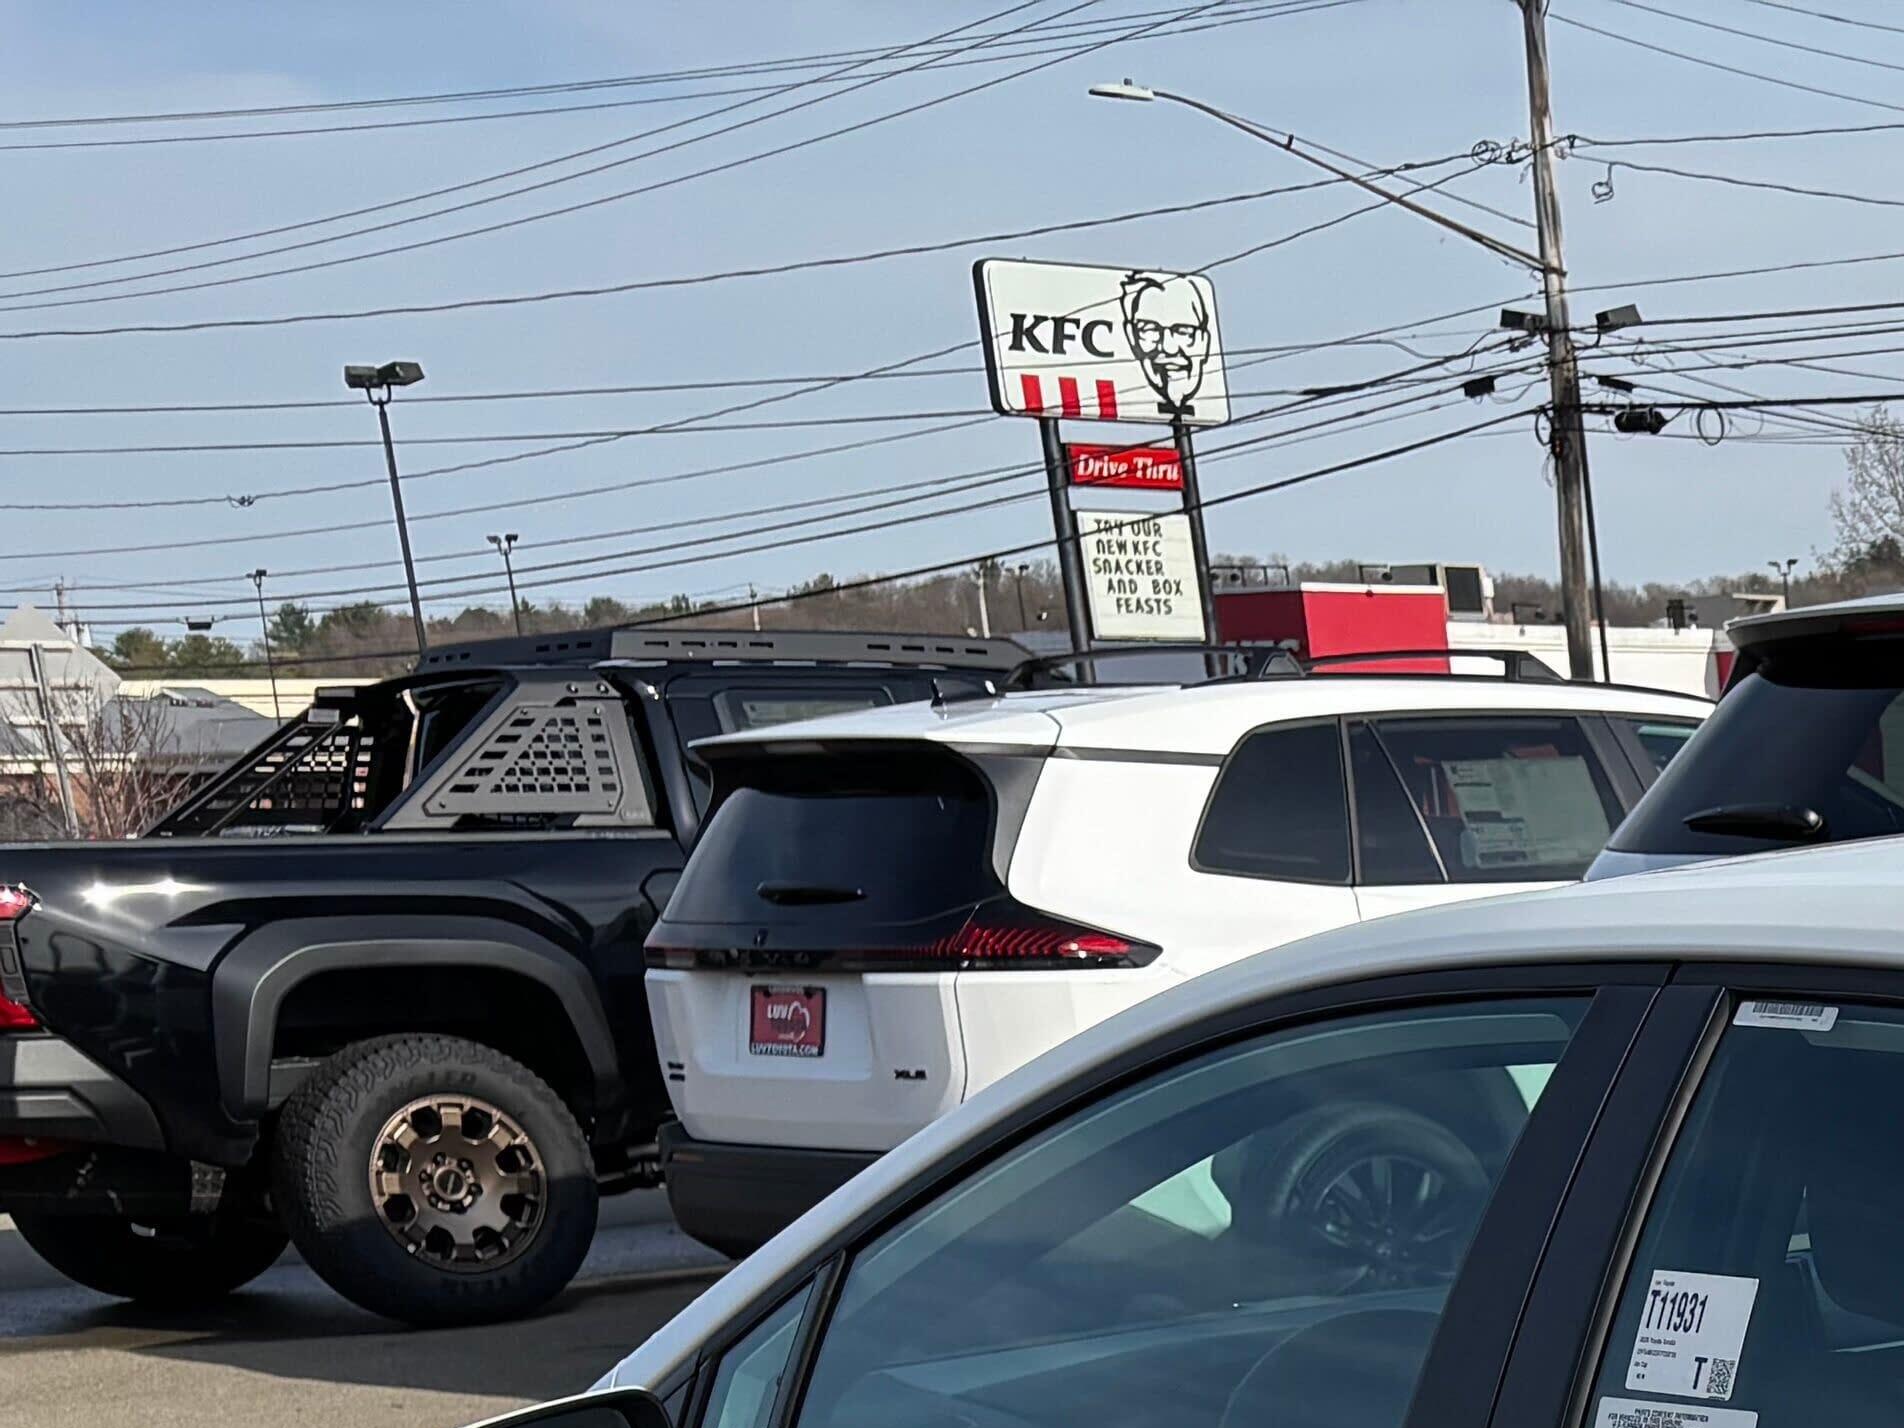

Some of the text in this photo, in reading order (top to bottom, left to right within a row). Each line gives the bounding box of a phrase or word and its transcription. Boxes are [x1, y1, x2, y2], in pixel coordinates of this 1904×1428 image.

[1008, 313, 1115, 358] KFC
[1077, 454, 1180, 481] Drive Thru
[1094, 519, 1163, 538] TRY OUR
[1096, 539, 1163, 557] NEW KFC
[1092, 557, 1165, 576] SNACKER
[1107, 577, 1183, 597] AND BOX
[1115, 597, 1173, 615] FEASTS
[767, 1003, 789, 1019] LUV
[1646, 1289, 1709, 1334] T11931
[1693, 1356, 1709, 1390] T
